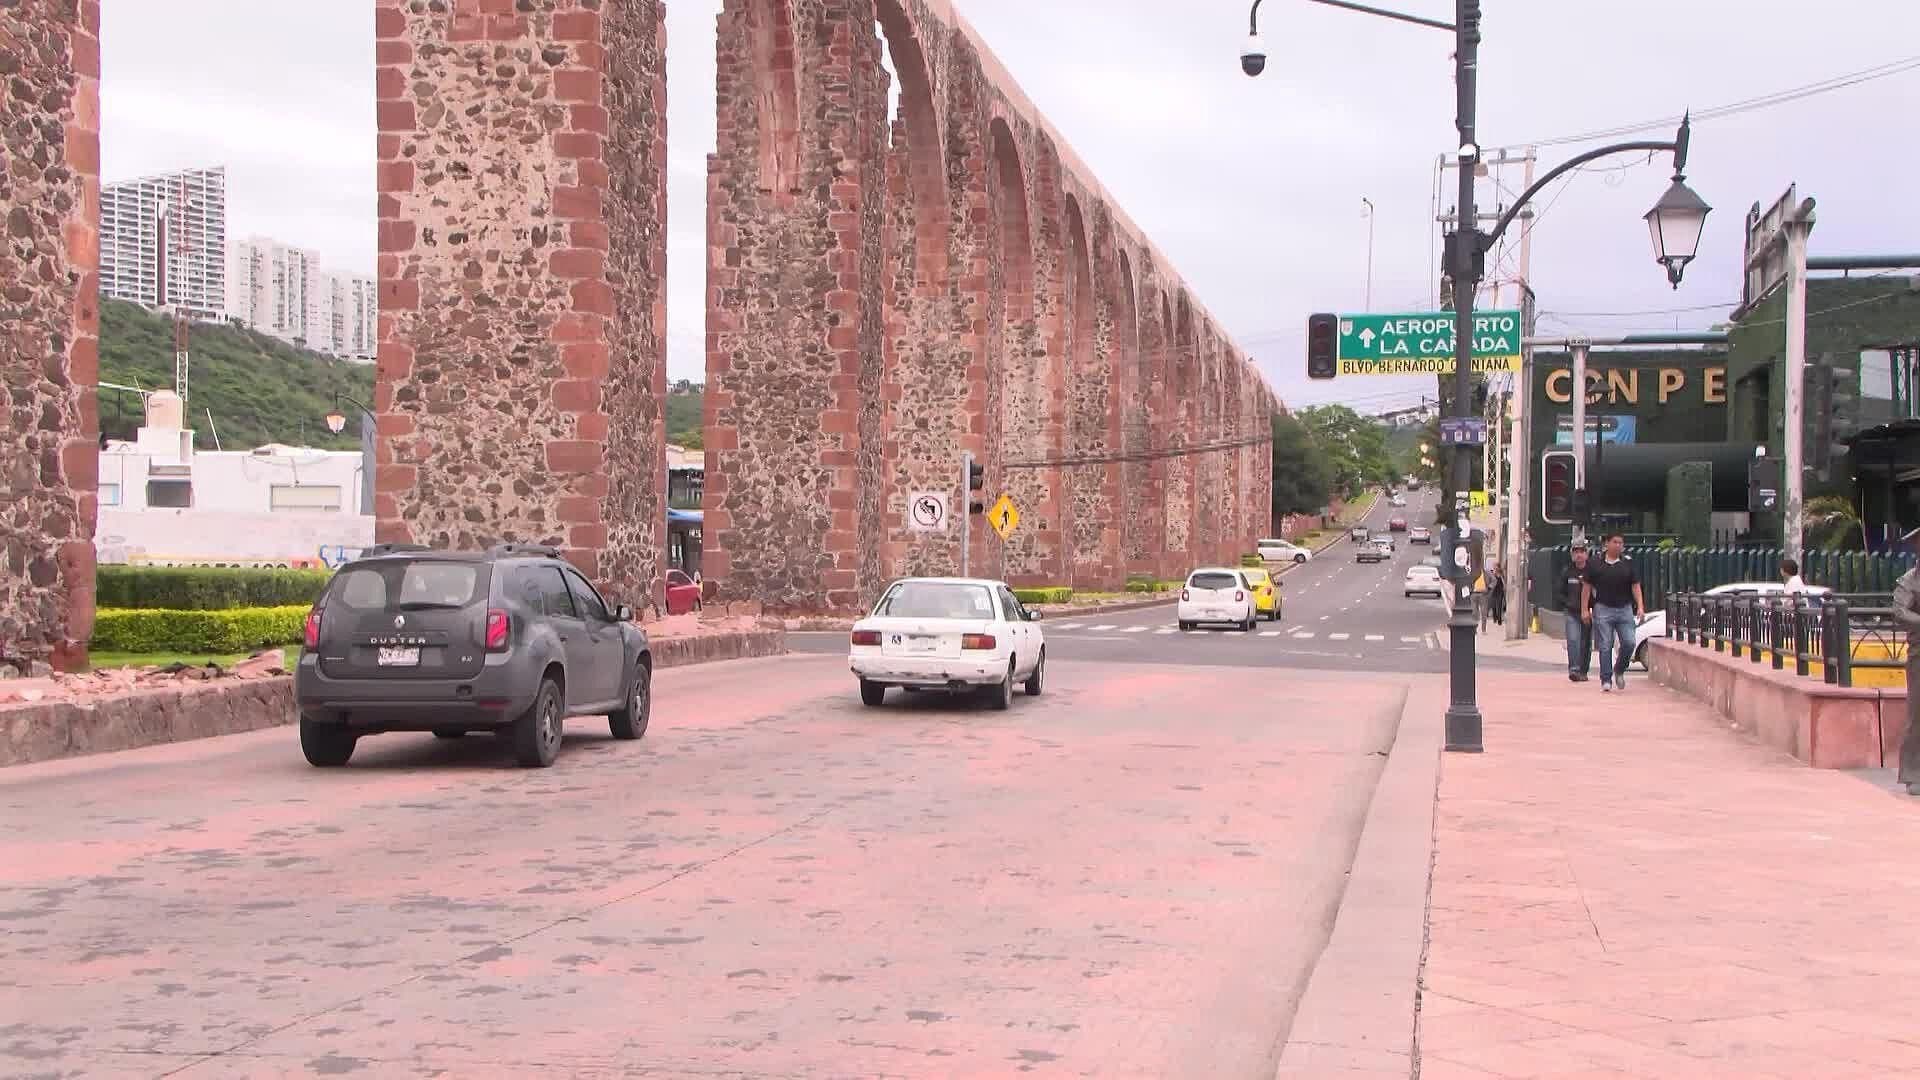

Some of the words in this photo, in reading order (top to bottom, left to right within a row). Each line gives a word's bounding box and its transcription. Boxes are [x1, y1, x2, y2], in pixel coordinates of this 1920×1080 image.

[1381, 317, 1514, 335] AEROPURTO
[1380, 339, 1408, 354] LA
[1343, 361, 1373, 374] BLVD
[1378, 359, 1445, 374] BERNARDO
[1450, 358, 1510, 372] QNTANA
